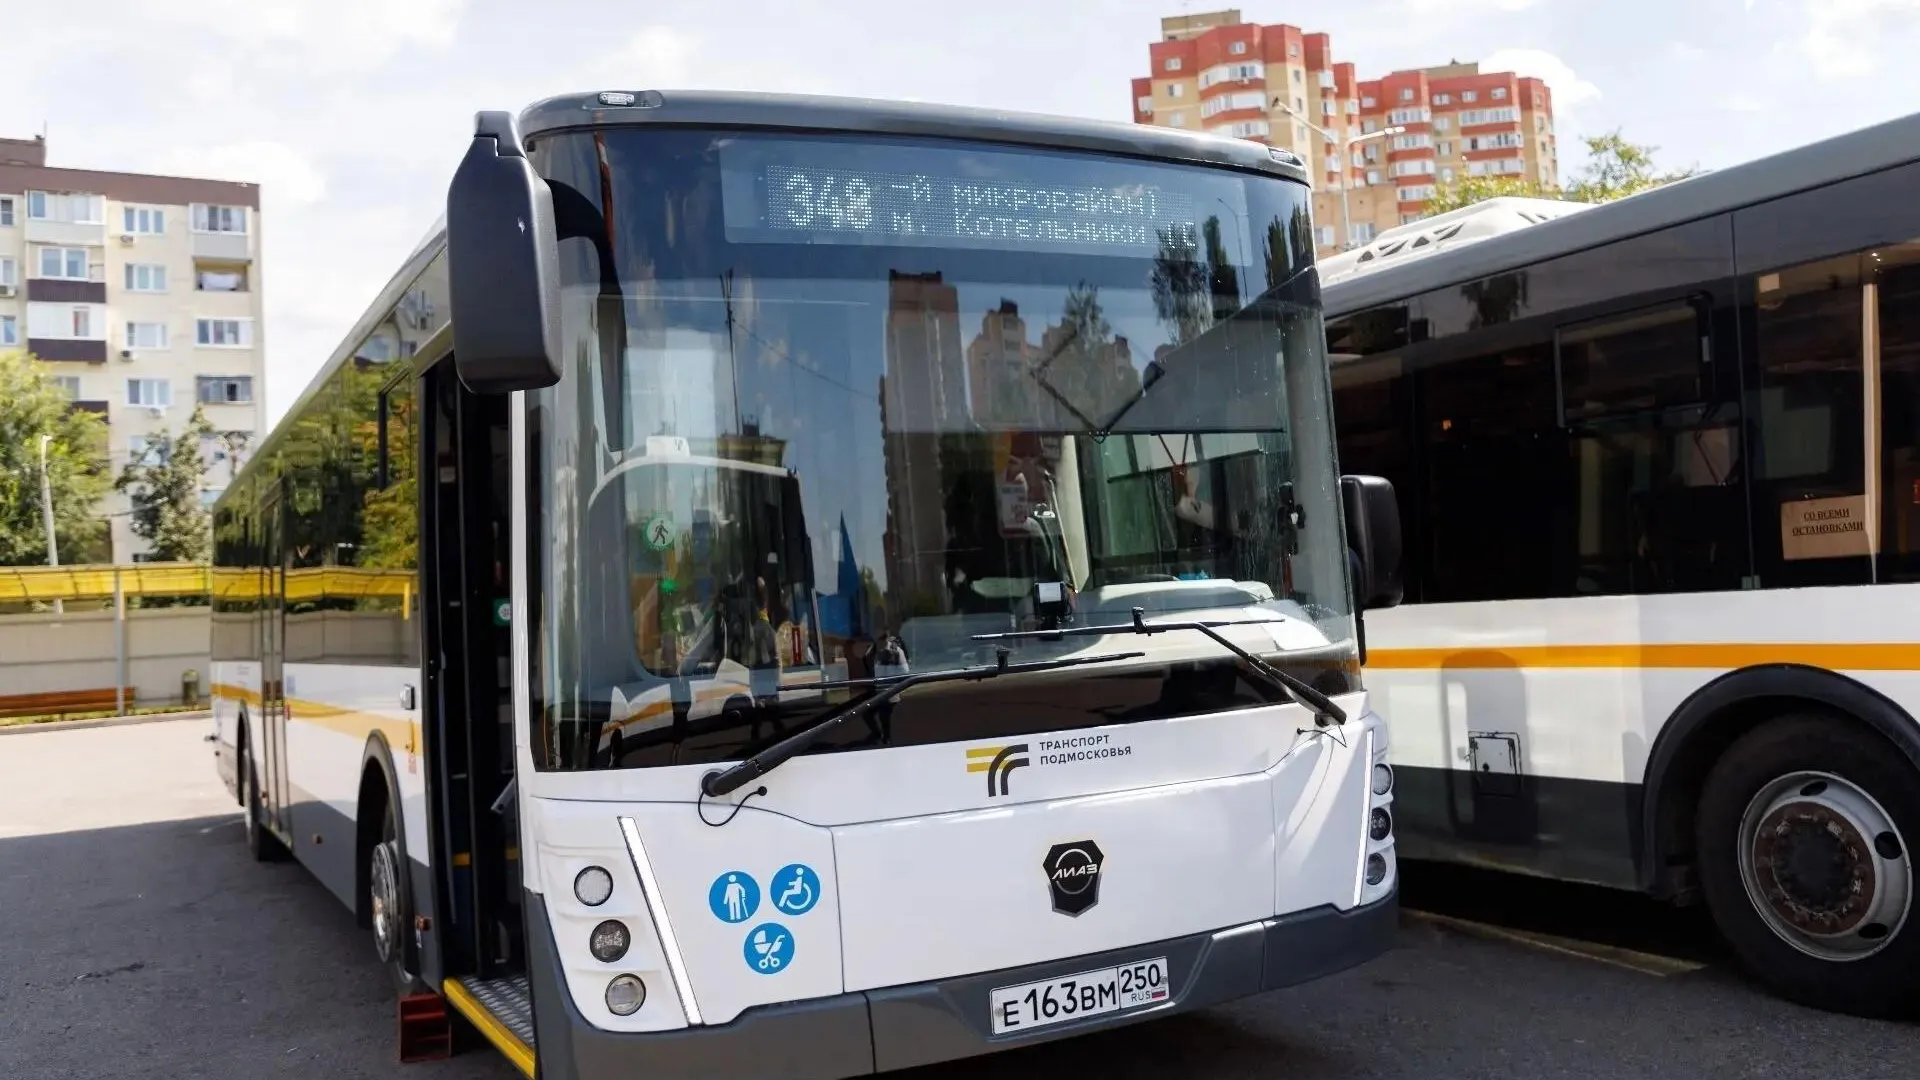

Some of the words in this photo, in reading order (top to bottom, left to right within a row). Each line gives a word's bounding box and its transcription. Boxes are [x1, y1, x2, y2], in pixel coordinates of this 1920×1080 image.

[786, 173, 873, 229] 348
[954, 207, 1146, 243] Котельники
[1803, 511, 1816, 521] СО
[1818, 507, 1851, 520] ВСЕМИ
[1792, 521, 1864, 536] ОСТАНОВКАМИ
[1039, 734, 1110, 751] ТРАНСПОРТ
[1040, 746, 1132, 765] ПОДМОСКОВЬЯ
[1051, 863, 1098, 880] ЛИАЗ
[1002, 980, 1117, 1028] Е163ВМ
[1119, 963, 1161, 994] 250
[1130, 990, 1151, 1002] RUS
